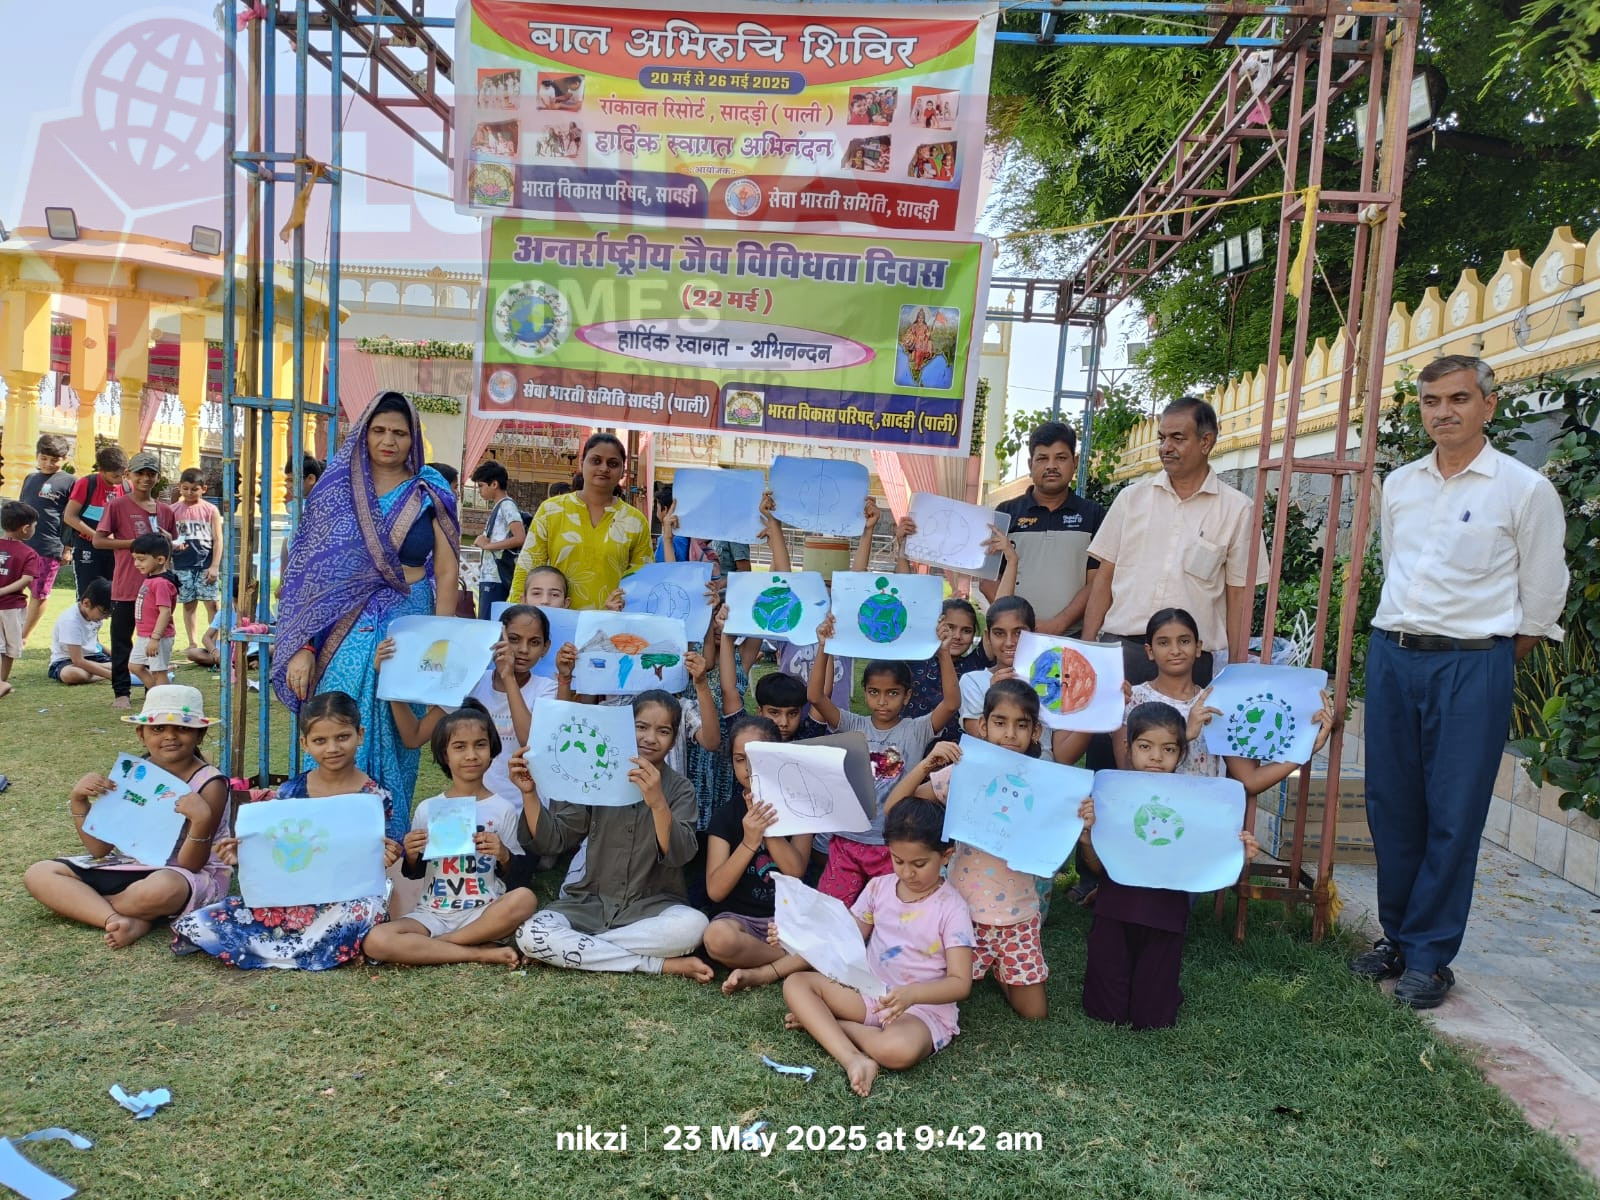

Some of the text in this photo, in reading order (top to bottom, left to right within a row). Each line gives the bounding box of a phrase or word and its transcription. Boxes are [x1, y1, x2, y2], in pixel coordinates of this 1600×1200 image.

[528, 18, 918, 68] बाल अभिरुचि शिविर
[651, 71, 790, 89] 20 मई से 26 मई 2025
[600, 94, 658, 117] रांकावत
[720, 100, 768, 126] सादड़ी
[595, 124, 834, 161] हार्दिक स्वागत अभिनंदन
[522, 180, 555, 198] भारत
[557, 178, 603, 200] विकास
[655, 183, 698, 208] सादड़ी
[768, 187, 797, 209] सेवा
[801, 189, 841, 211] भारती
[896, 199, 939, 223] सादड़ी
[514, 231, 949, 289] अन्तर्राष्ट्रीय जैव विविधता दिवस
[618, 324, 670, 351] हार्दिक
[676, 335, 730, 357] स्वागत
[750, 332, 832, 363] अभिनन्दन
[523, 380, 548, 399] सेवा
[549, 383, 584, 403] भारती
[587, 387, 625, 407] समिति
[627, 392, 665, 414] सादड़ी
[667, 392, 710, 417] (पाली)
[768, 403, 797, 420] भारत
[798, 402, 836, 424] विकास
[881, 410, 916, 433] सादड़ी
[918, 411, 957, 436] (पाली)
[442, 854, 492, 875] KIDS
